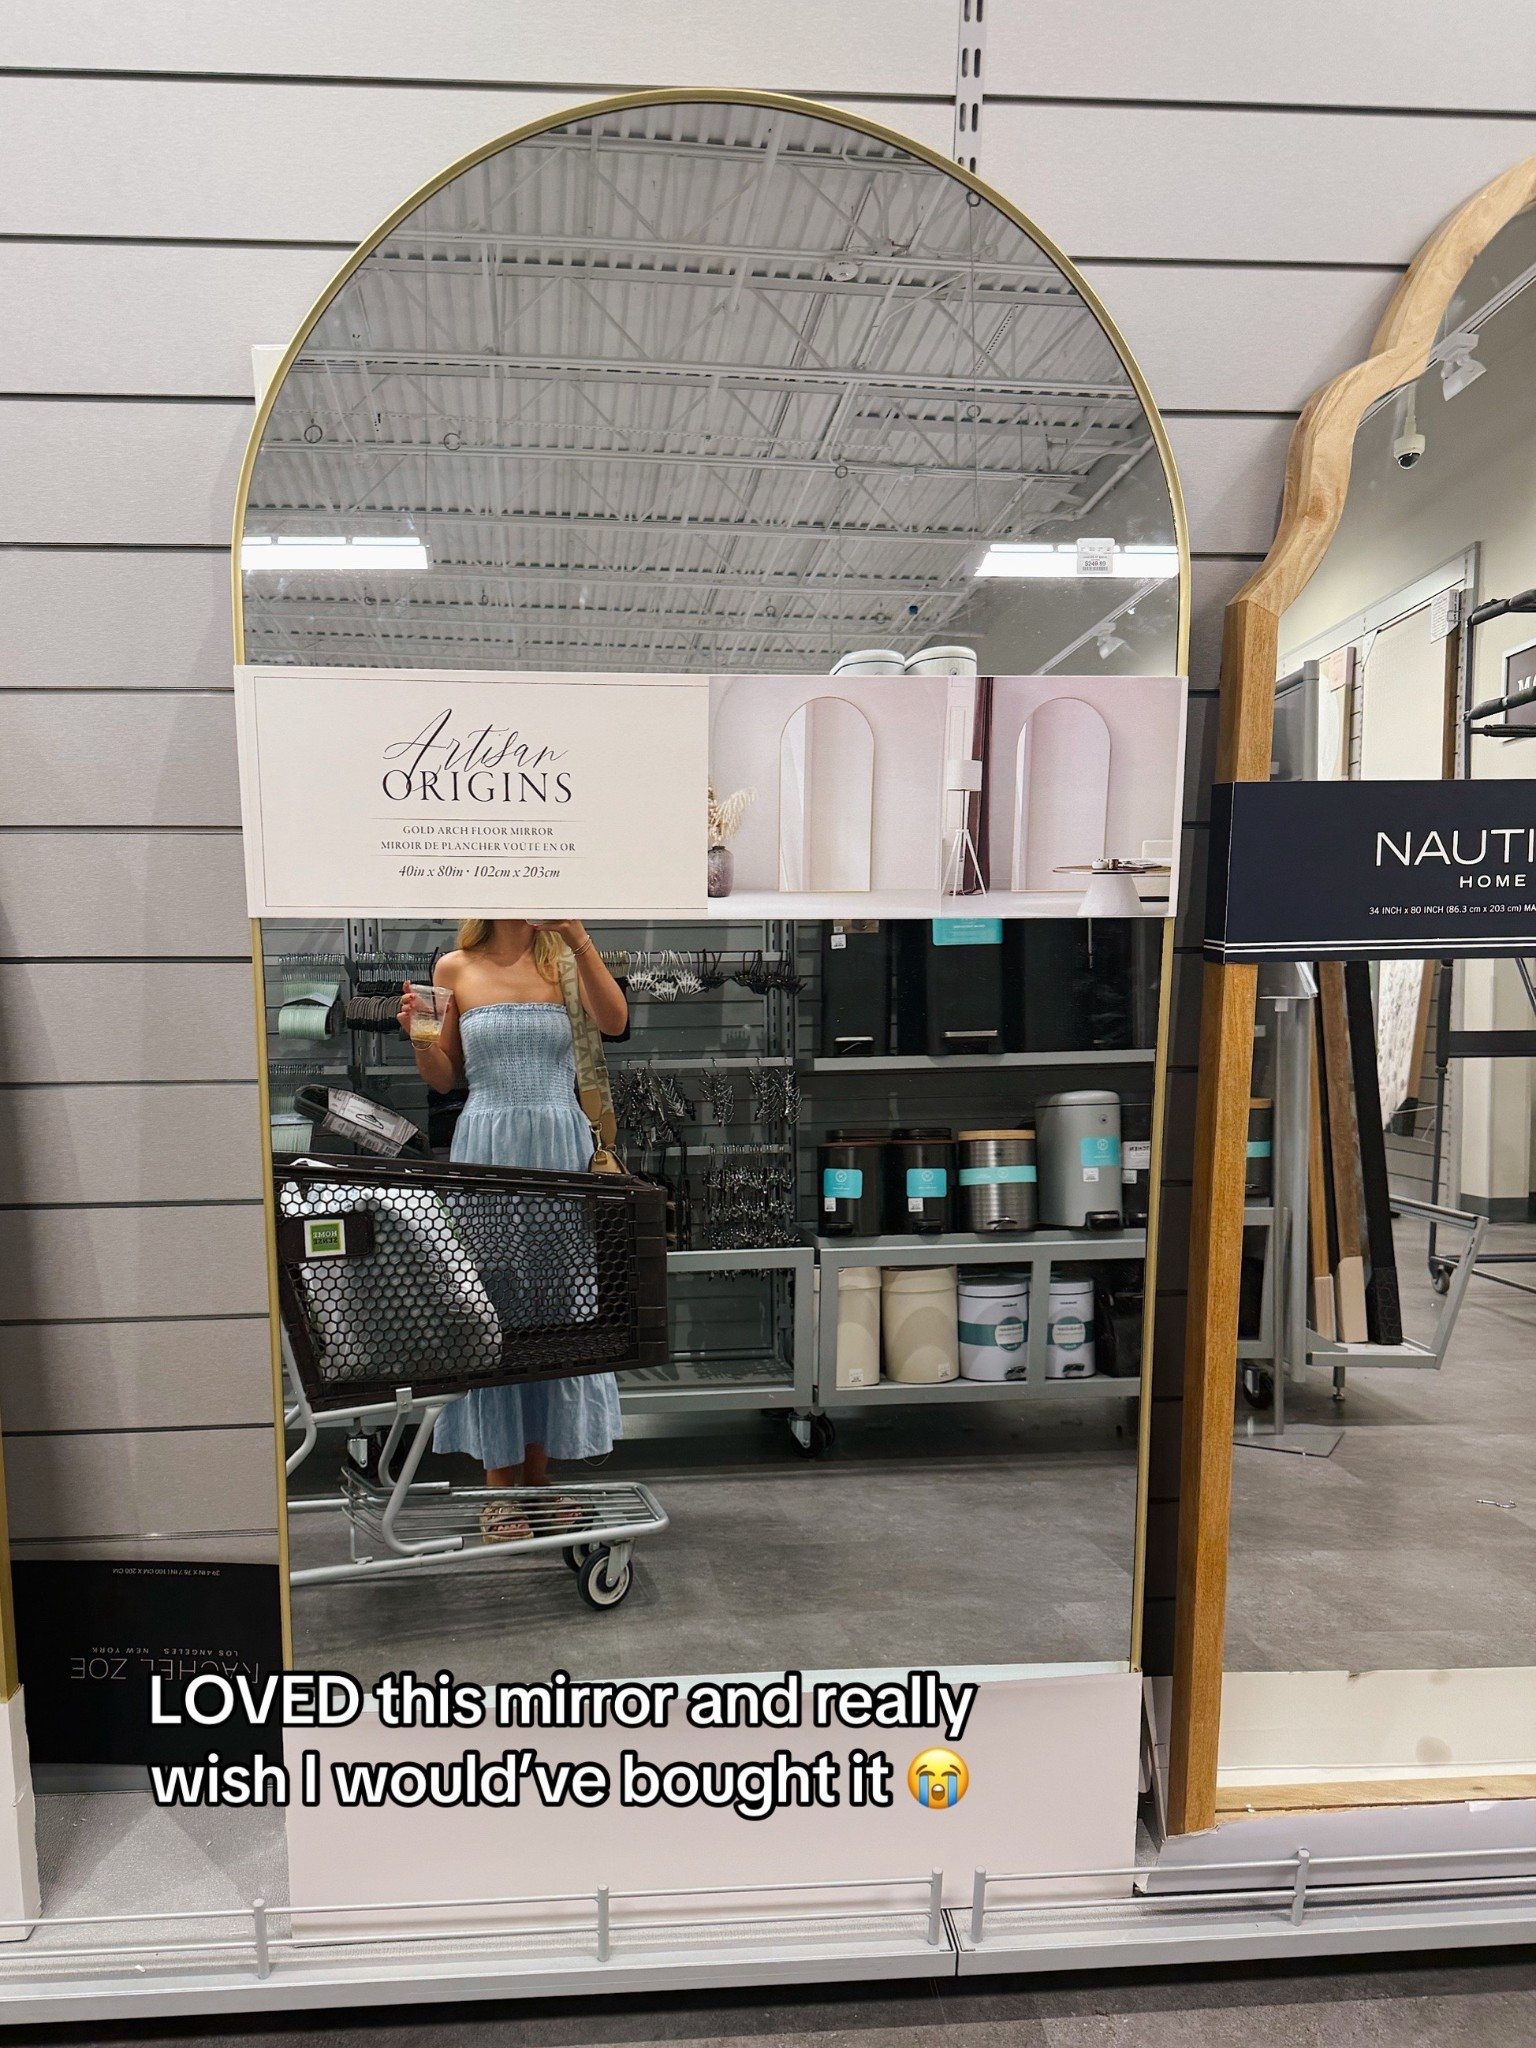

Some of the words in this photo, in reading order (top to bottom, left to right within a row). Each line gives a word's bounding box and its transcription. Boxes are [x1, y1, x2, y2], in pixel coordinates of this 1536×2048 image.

[383, 708, 569, 792] Artisan
[382, 769, 572, 803] ORIGINS
[402, 825, 435, 835] GOLD
[437, 825, 469, 836] ARCH
[471, 826, 508, 836] FLOOR
[510, 827, 554, 836] MIRROR
[381, 841, 422, 850] MIROIR
[424, 841, 439, 850] DE
[441, 842, 501, 851] PLANCHER
[543, 842, 557, 852] EN
[559, 842, 576, 852] OR
[1375, 828, 1535, 866] NAUTI
[398, 865, 425, 878] 40in
[427, 868, 434, 877] x
[436, 865, 464, 878] 80in
[473, 866, 511, 878] 102cm
[512, 869, 521, 878] x
[522, 866, 561, 878] 203cm
[1459, 874, 1527, 889] HOME
[1368, 906, 1380, 915] 34
[1382, 906, 1402, 915] INCH
[1410, 906, 1422, 914] 80
[1423, 905, 1444, 914] INCH
[1446, 905, 1467, 914] (86.3
[1489, 904, 1505, 913] 203
[1507, 904, 1522, 913] cm)
[163, 1648, 213, 1656] ANGELES
[70, 1657, 128, 1680] ZOE
